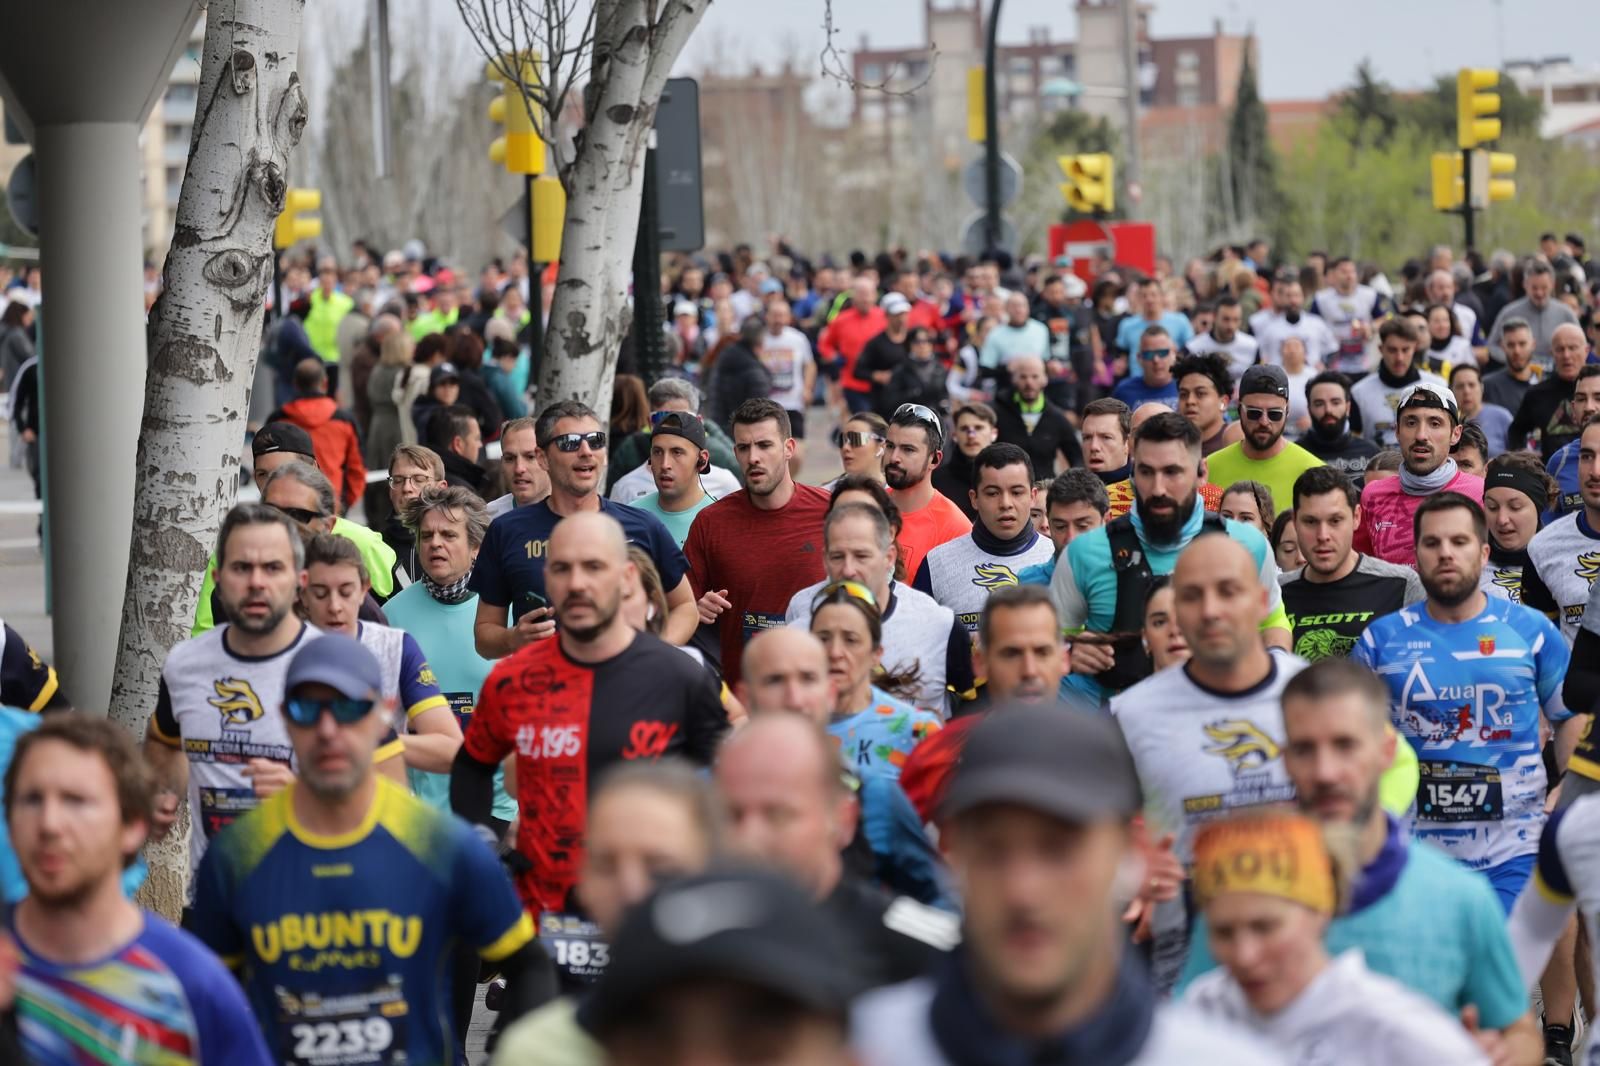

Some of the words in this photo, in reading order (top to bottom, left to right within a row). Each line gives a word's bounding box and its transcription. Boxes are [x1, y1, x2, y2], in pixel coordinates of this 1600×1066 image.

[1297, 611, 1375, 627] SCOTT
[1426, 783, 1489, 807] 1547
[252, 908, 424, 964] UBUNTU
[290, 1015, 394, 1060] 2239
